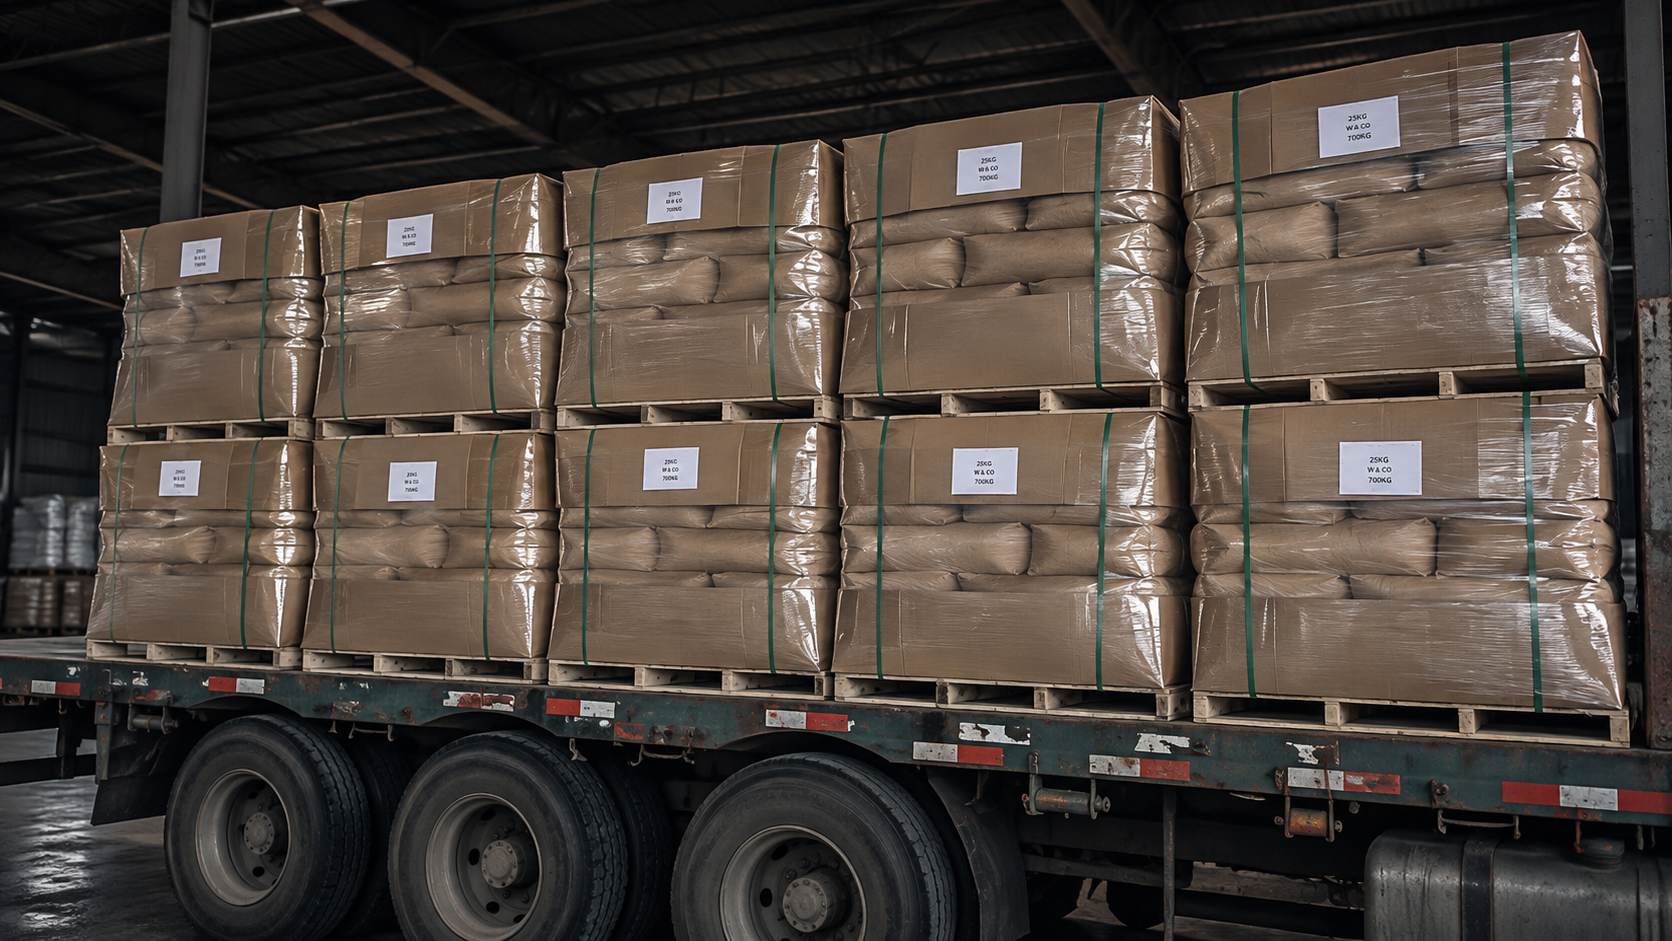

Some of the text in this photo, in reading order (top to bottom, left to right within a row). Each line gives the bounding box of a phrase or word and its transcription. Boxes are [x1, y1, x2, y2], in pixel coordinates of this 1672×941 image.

[1348, 113, 1367, 122] 25KG
[1347, 132, 1372, 141] 700KG
[1369, 456, 1389, 464] 25KG
[1368, 476, 1392, 484] 700KG
